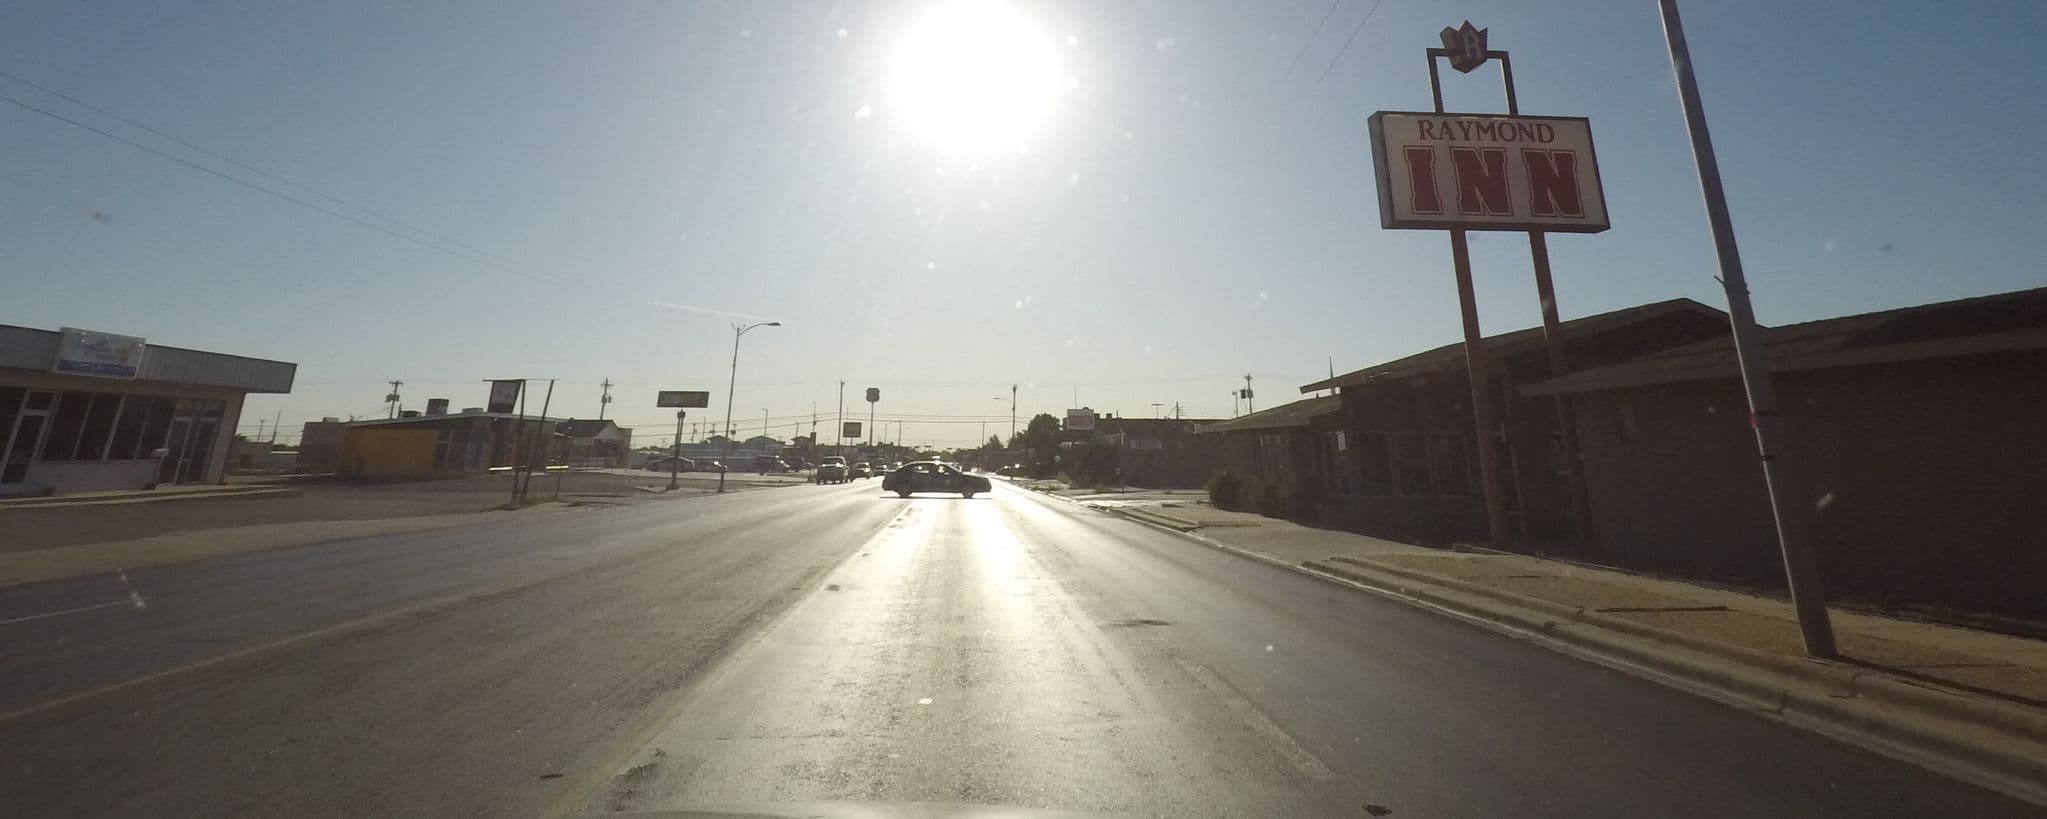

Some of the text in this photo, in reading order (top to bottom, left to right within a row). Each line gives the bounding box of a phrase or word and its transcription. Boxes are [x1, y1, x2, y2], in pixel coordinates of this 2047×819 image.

[1463, 32, 1481, 57] R
[1418, 120, 1554, 143] RAYMOND
[1404, 146, 1585, 218] INN
